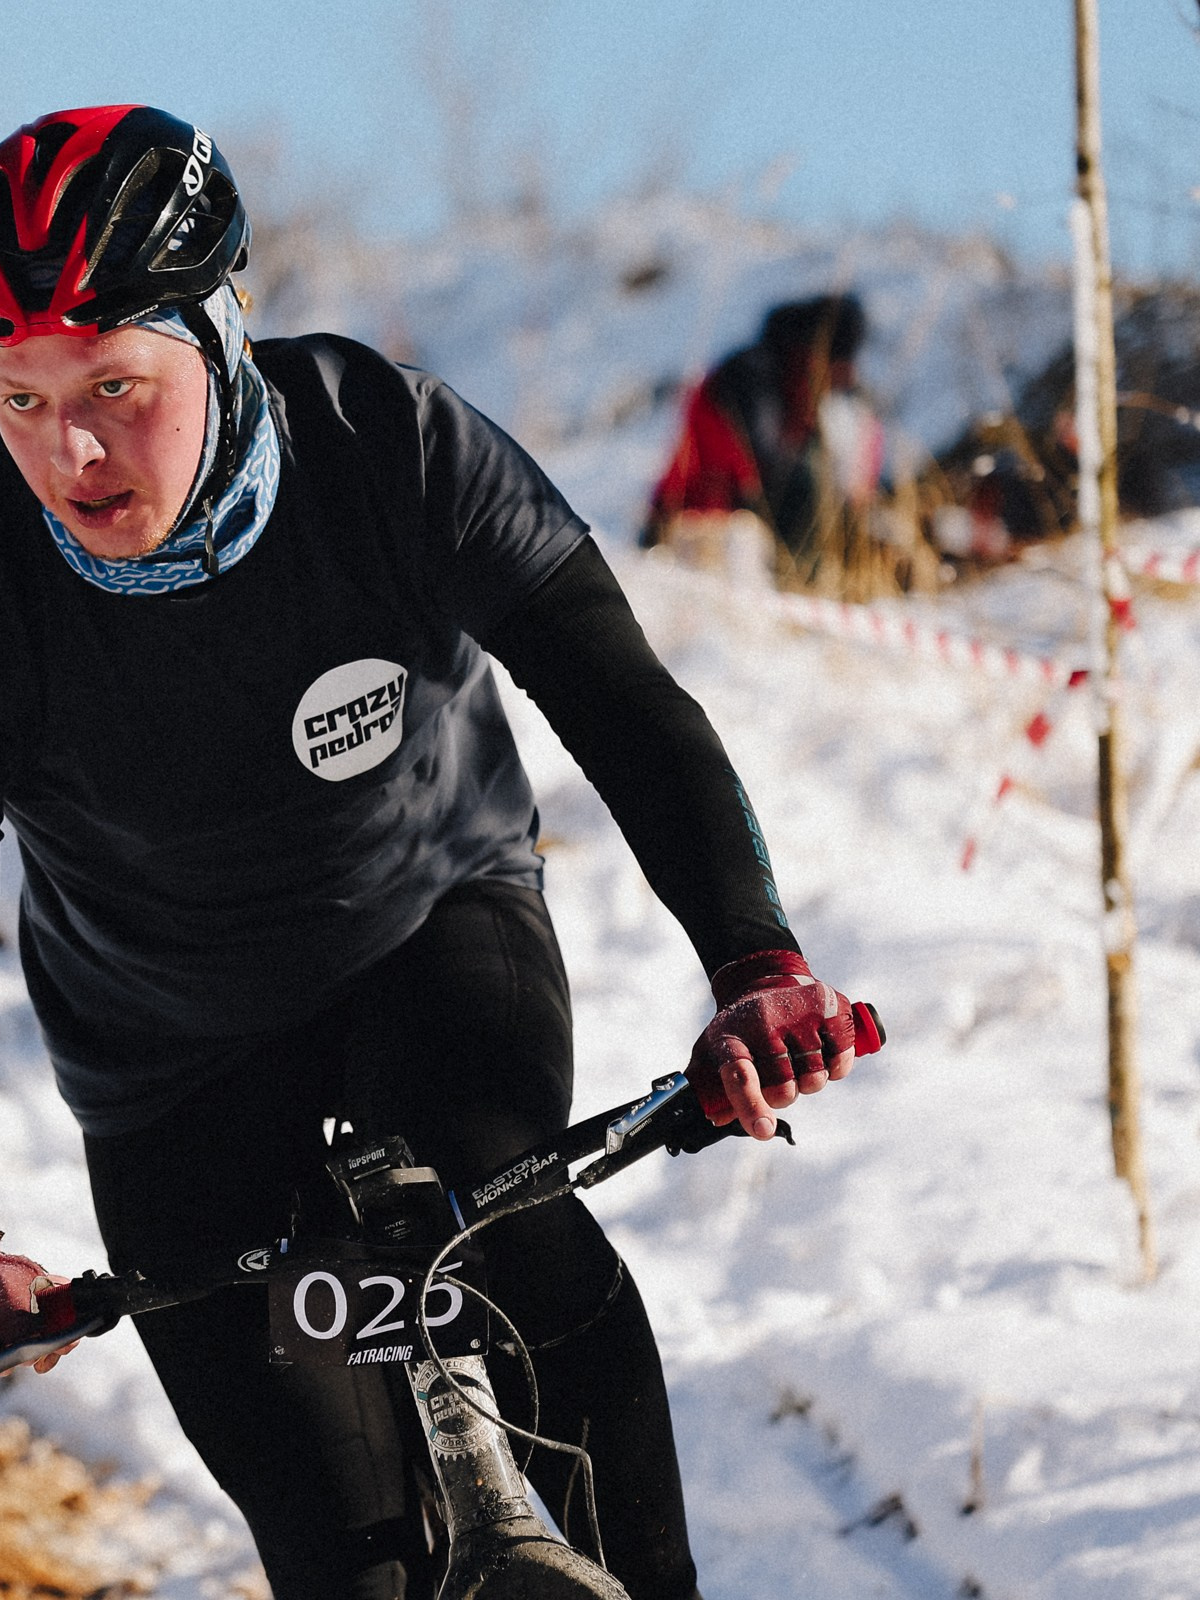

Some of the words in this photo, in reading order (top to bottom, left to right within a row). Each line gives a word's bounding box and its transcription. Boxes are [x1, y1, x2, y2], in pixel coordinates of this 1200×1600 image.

[131, 304, 159, 320] GIRO
[303, 672, 404, 741] crazy
[472, 1155, 538, 1200] EASTON
[476, 1169, 530, 1209] MONKEY
[531, 1152, 559, 1174] BAR
[347, 1345, 413, 1366] FATRACING
